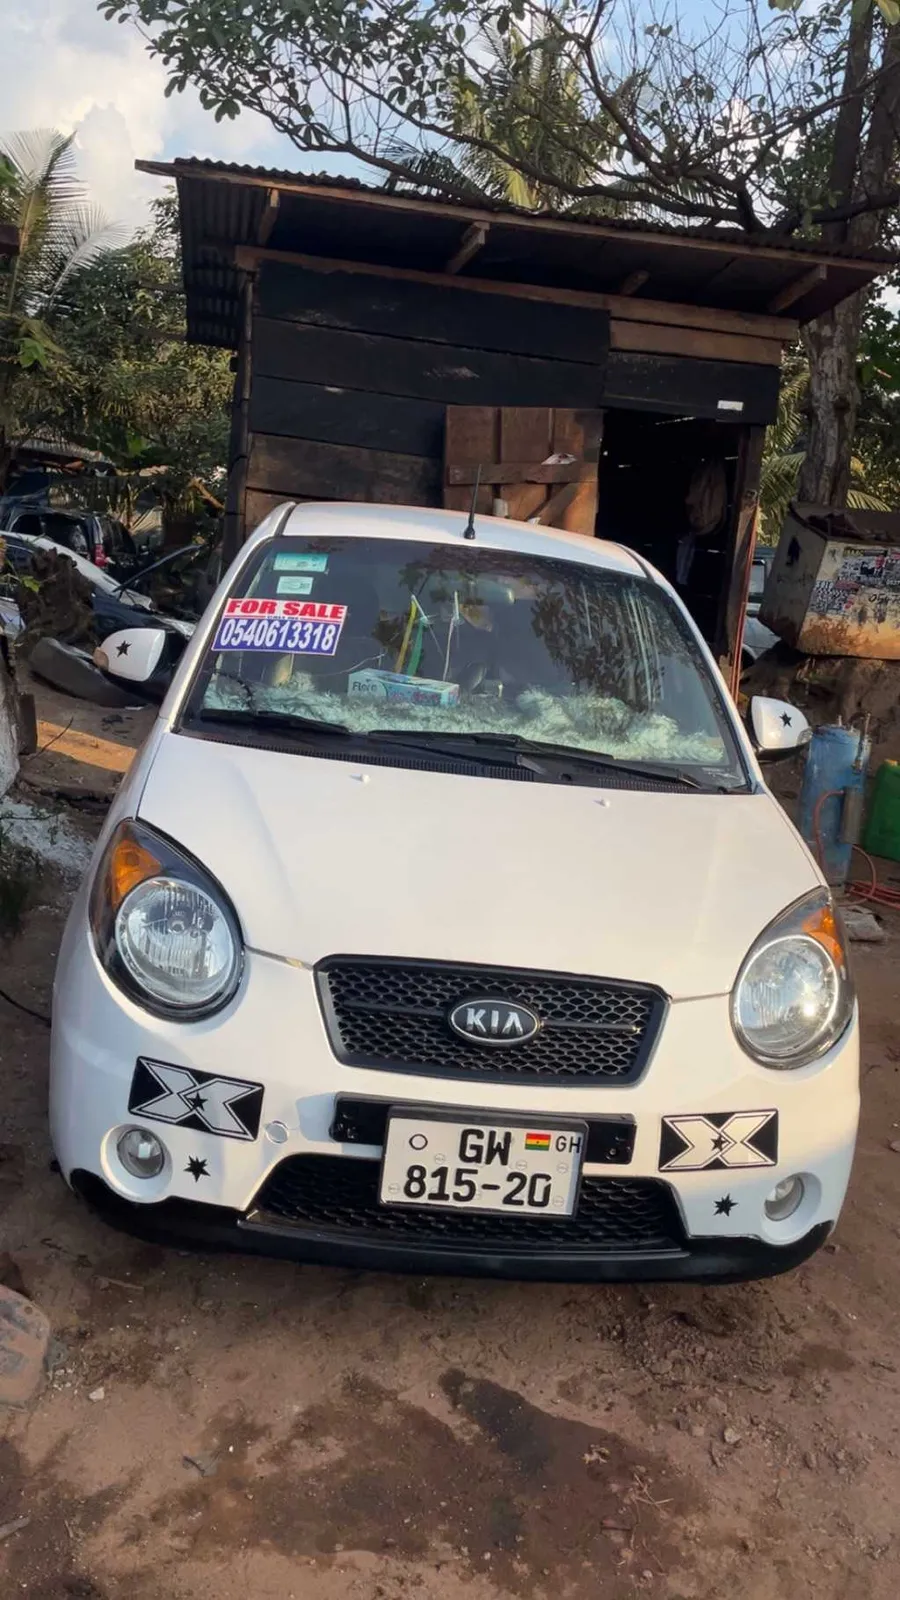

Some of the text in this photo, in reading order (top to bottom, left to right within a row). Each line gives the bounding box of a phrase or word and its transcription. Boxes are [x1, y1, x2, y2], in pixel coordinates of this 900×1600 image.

[227, 600, 345, 619] FOR SALE
[220, 619, 336, 651] 0540613318
[466, 1008, 523, 1036] KIA
[458, 1128, 512, 1166] GW
[555, 1135, 582, 1153] GH
[403, 1165, 552, 1208] 815-20
